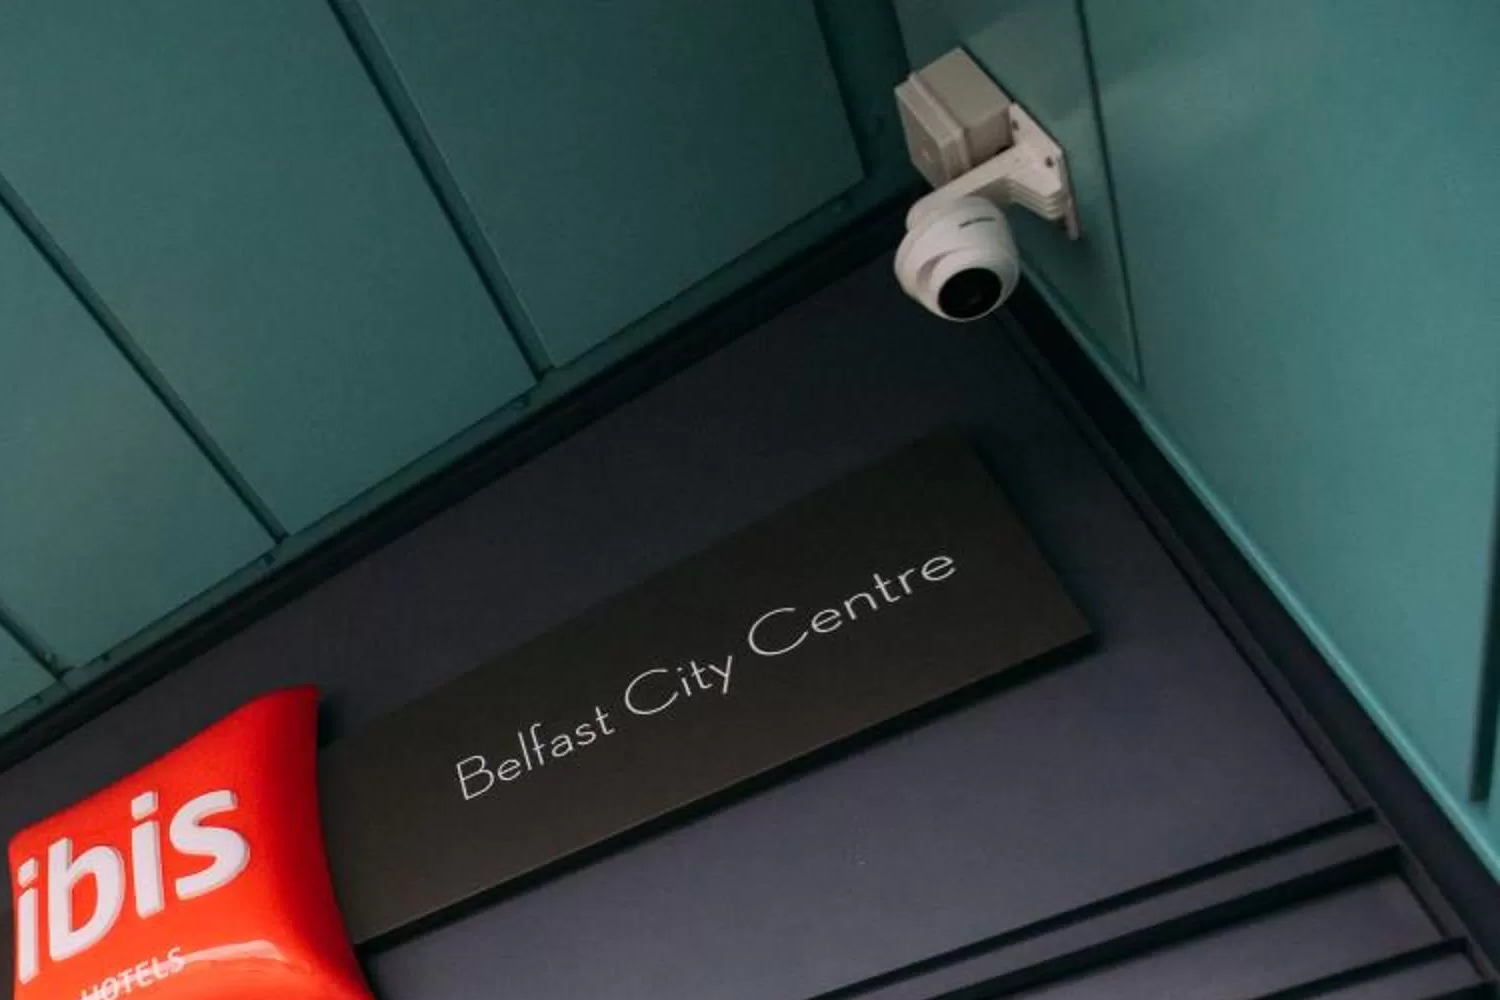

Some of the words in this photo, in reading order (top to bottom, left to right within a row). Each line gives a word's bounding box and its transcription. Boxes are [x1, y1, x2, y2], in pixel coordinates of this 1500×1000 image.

[456, 706, 615, 800] Belfast
[624, 655, 734, 716] City
[747, 554, 957, 656] Centre
[16, 789, 250, 986] ibis
